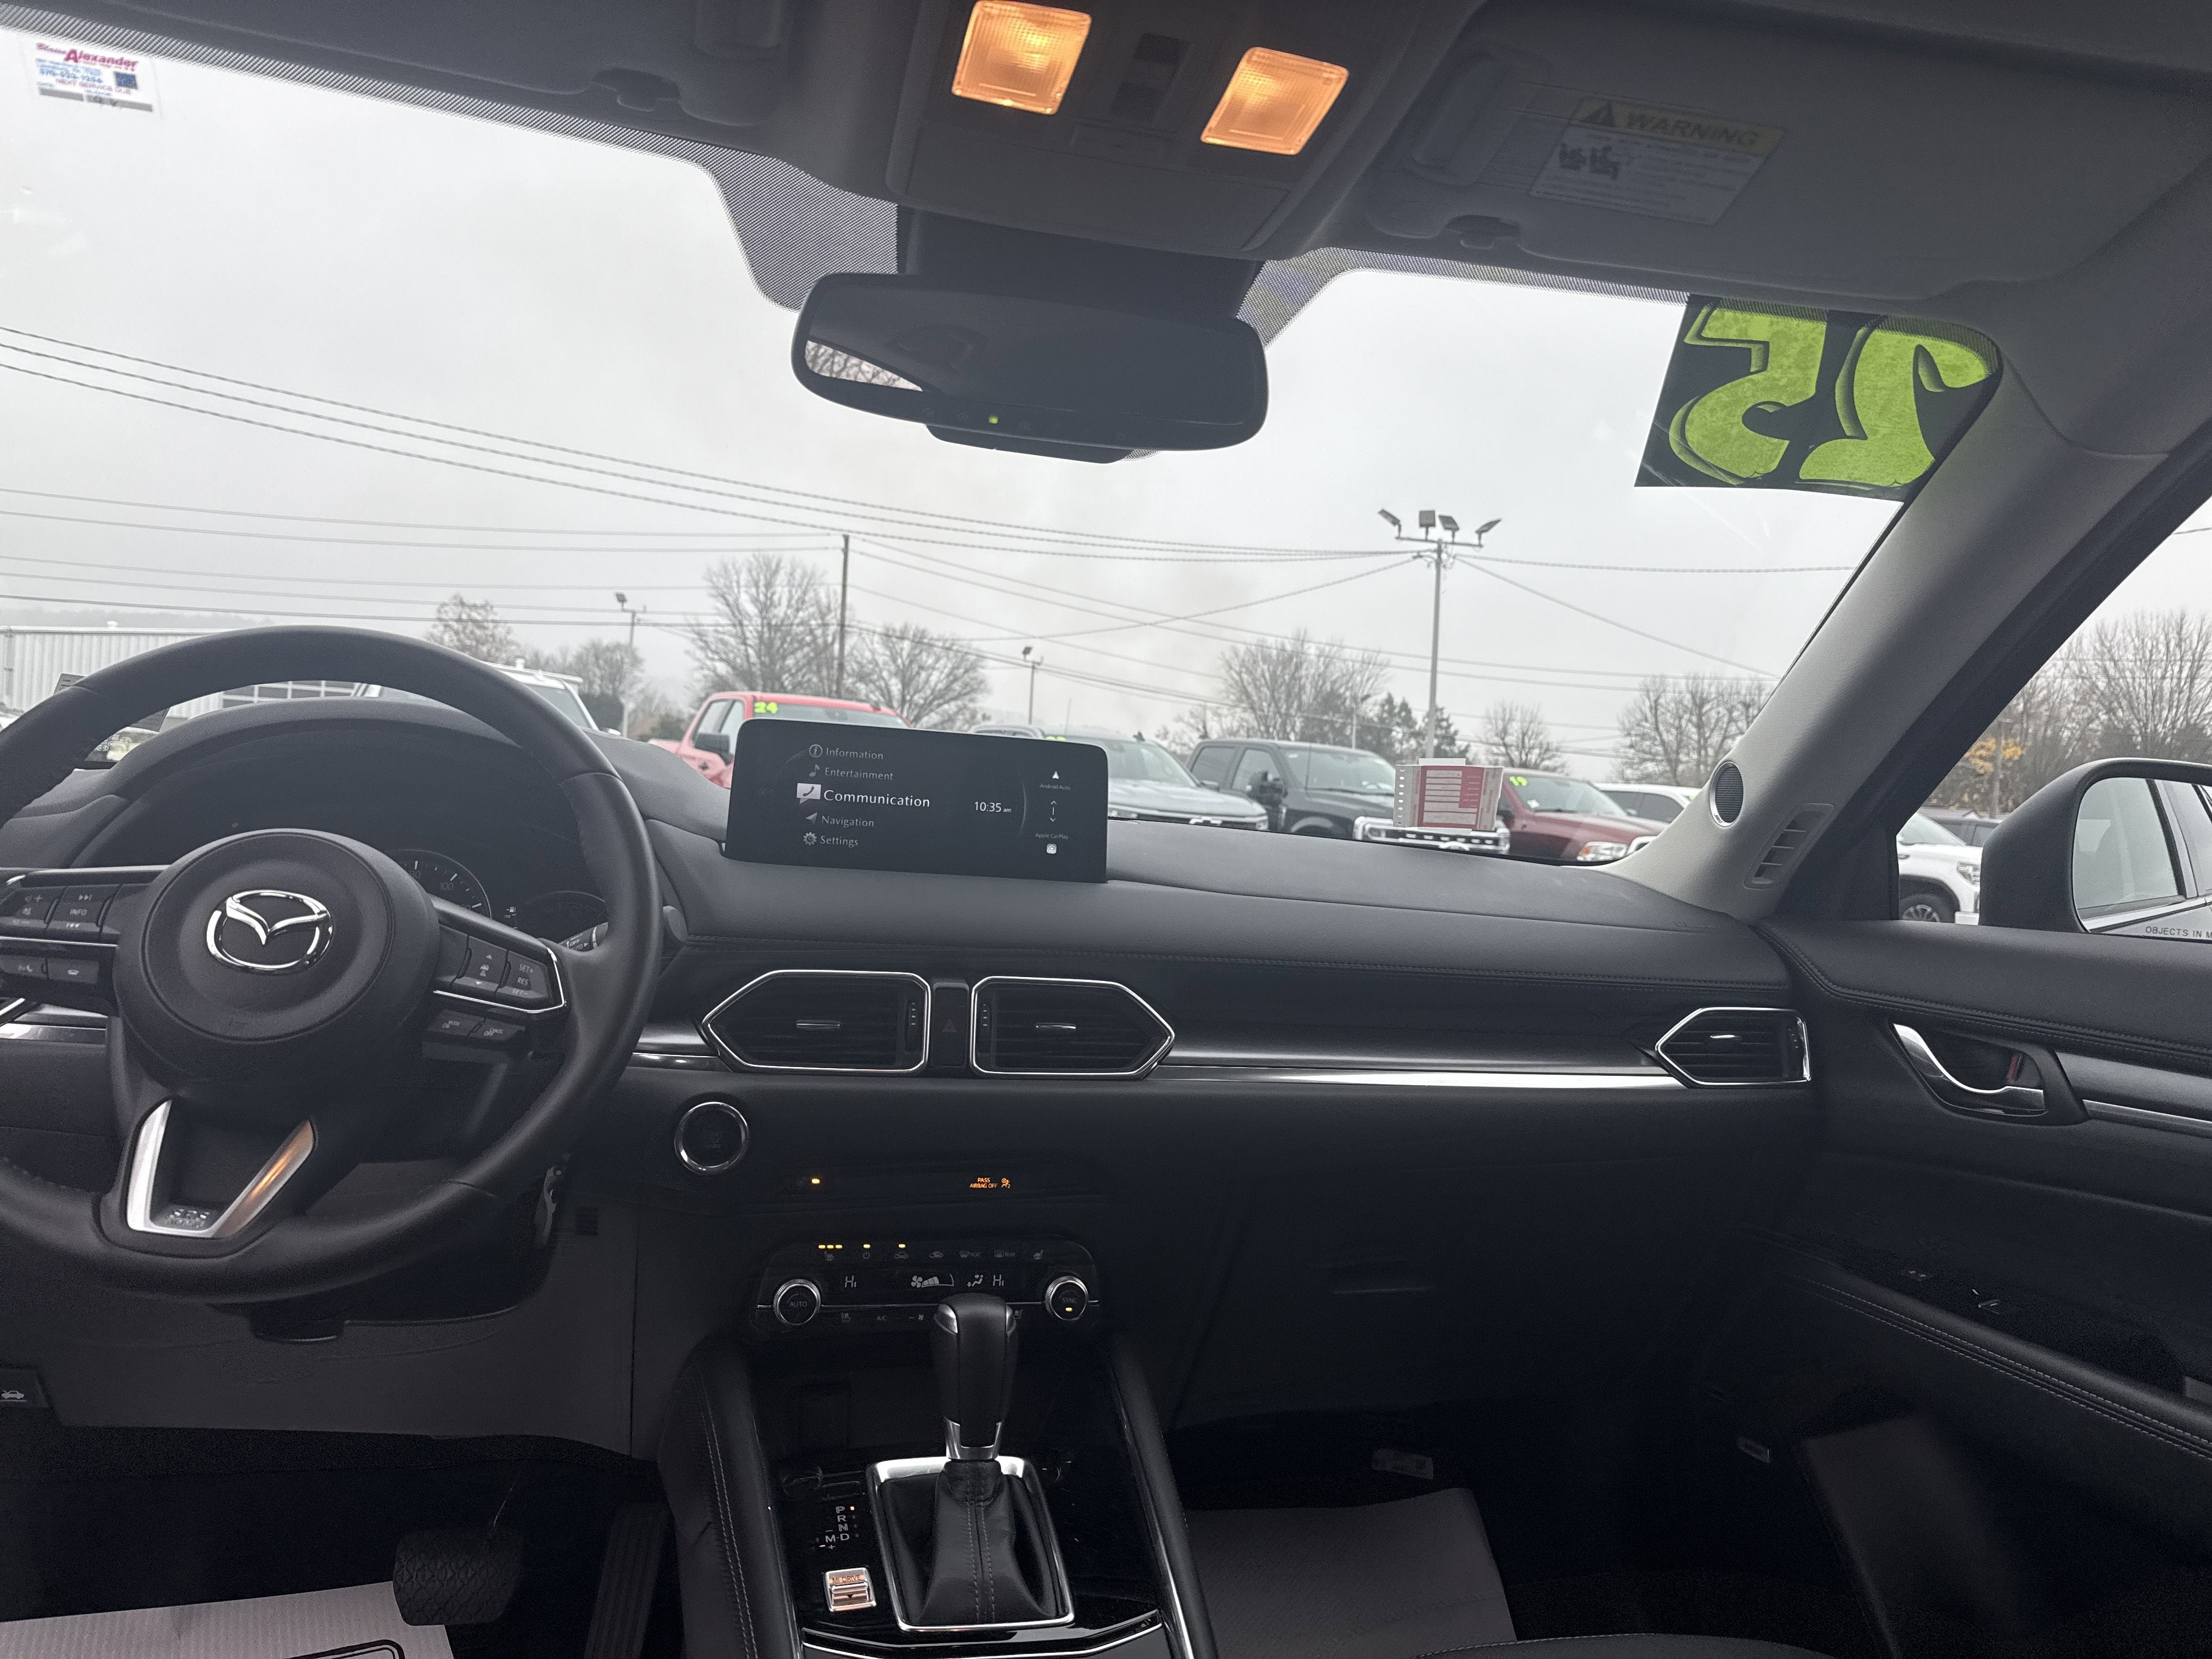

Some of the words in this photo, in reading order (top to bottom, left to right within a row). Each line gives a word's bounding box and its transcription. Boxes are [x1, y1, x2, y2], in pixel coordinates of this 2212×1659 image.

[63, 49, 138, 67] Alexander
[1626, 111, 1759, 147] WARNING
[826, 747, 883, 761] Information
[825, 768, 894, 781] Entertainment
[823, 789, 930, 808] Communication
[974, 802, 1002, 812] 10:35
[822, 816, 874, 828] Navigation
[820, 836, 859, 848] Settings
[439, 882, 454, 891] 100
[2145, 926, 2189, 937] OBJECTS
[2192, 930, 2202, 938] IN
[517, 977, 528, 985] RES
[836, 1506, 845, 1514] P
[838, 1523, 849, 1532] N
